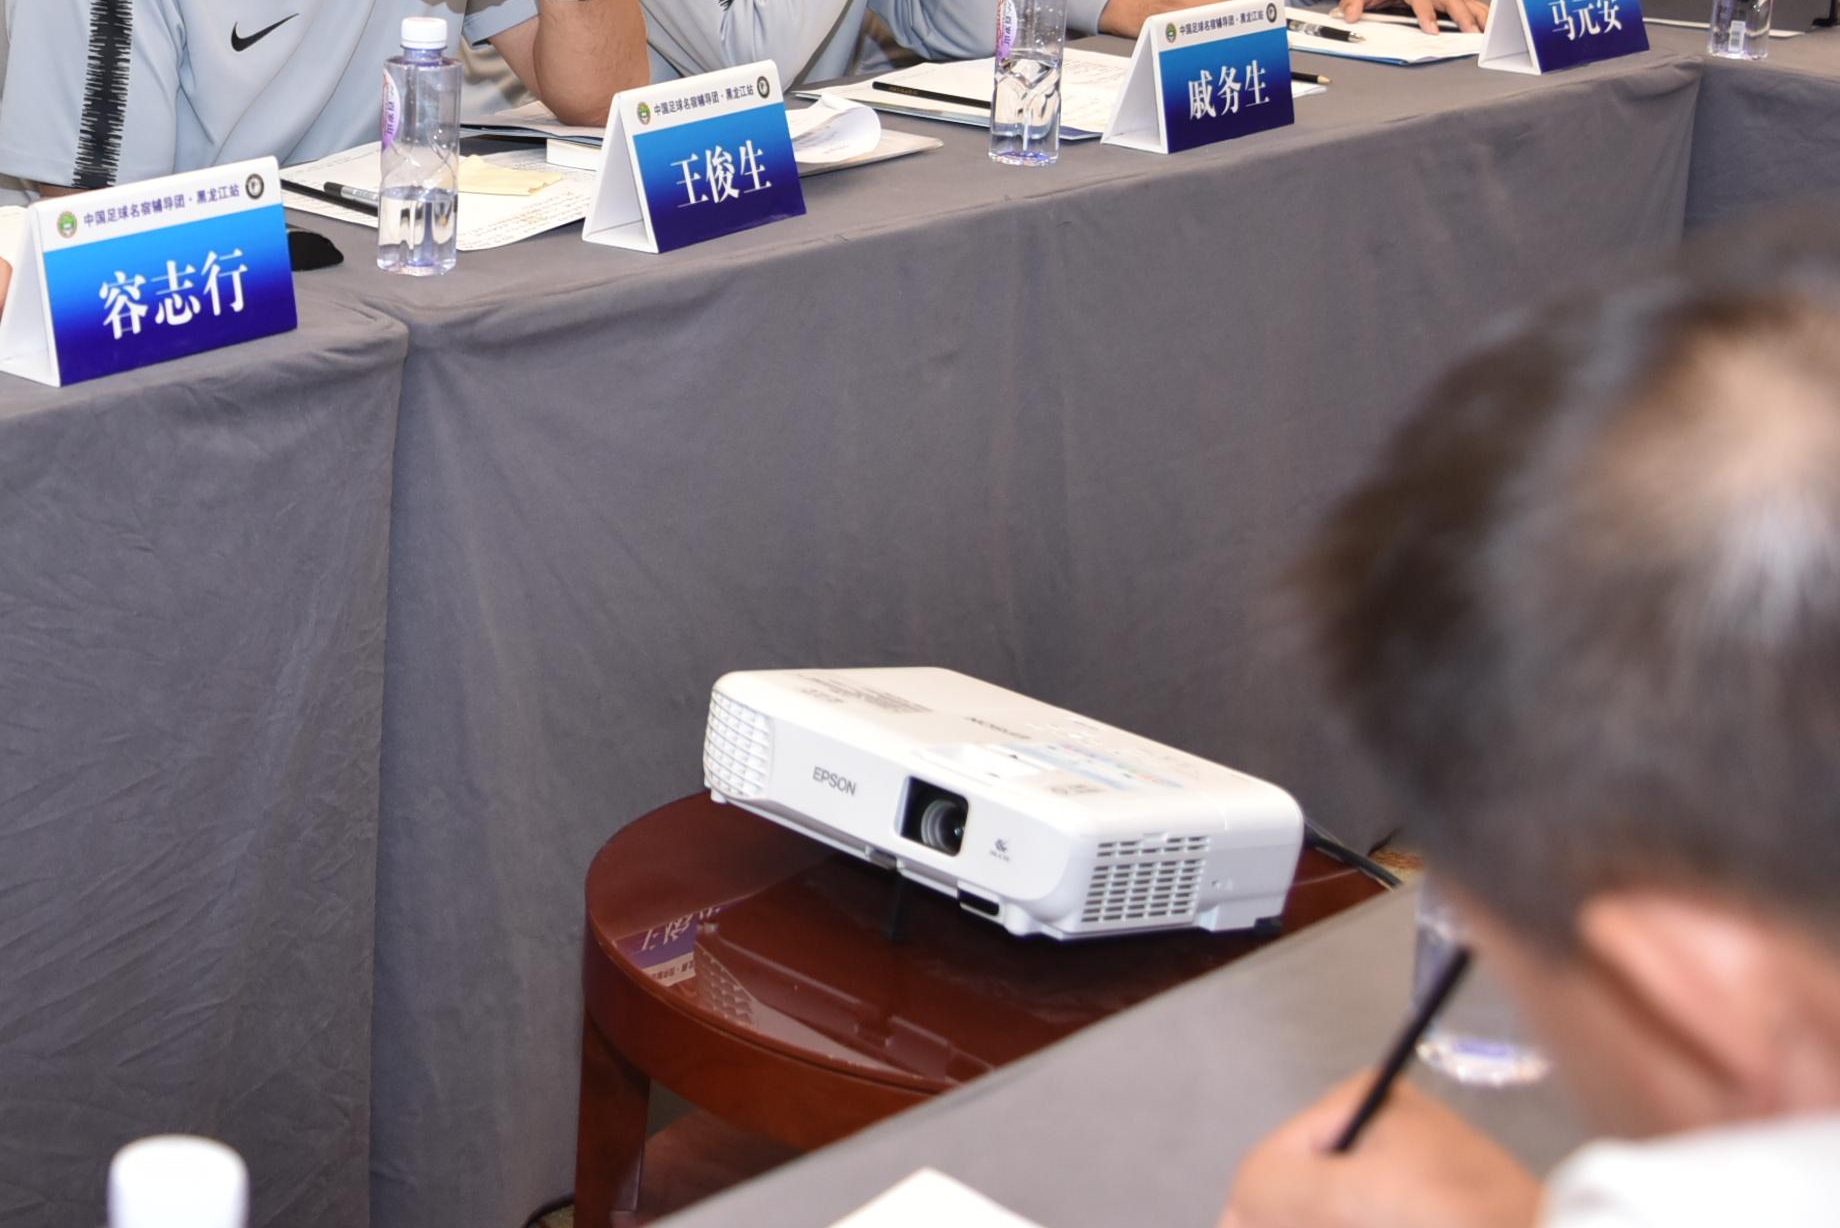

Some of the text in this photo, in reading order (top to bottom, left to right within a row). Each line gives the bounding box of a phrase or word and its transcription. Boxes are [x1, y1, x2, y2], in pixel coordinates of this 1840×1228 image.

[1188, 59, 1270, 120] 戚务生
[670, 139, 772, 208] 王俊生
[99, 247, 248, 340] 容志行
[813, 765, 857, 797] EPSON
